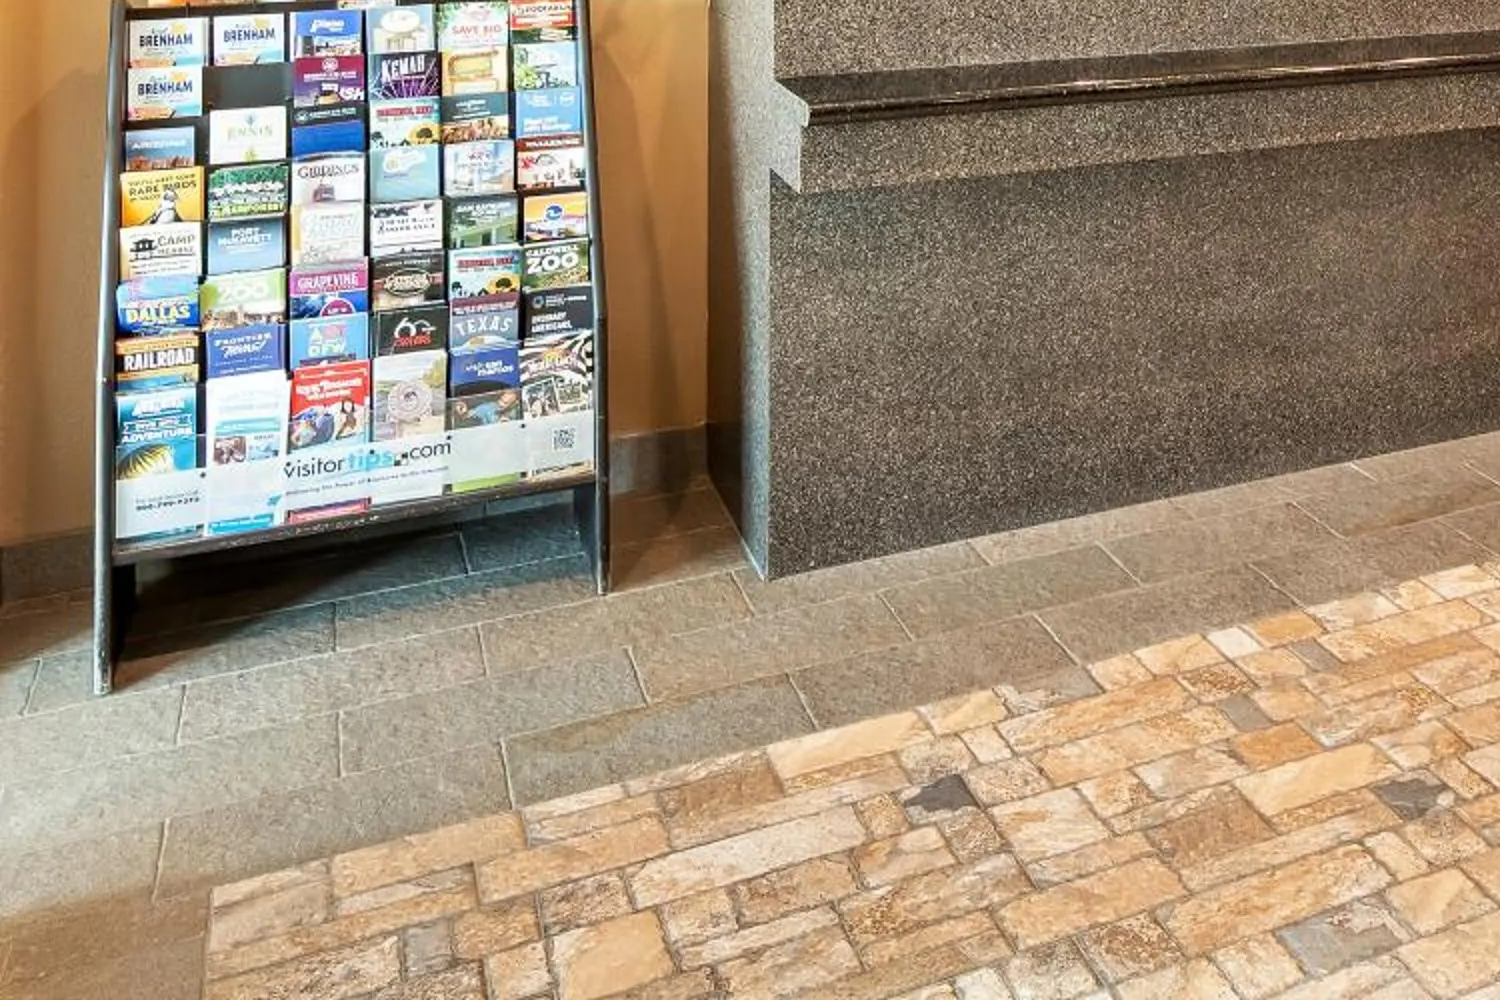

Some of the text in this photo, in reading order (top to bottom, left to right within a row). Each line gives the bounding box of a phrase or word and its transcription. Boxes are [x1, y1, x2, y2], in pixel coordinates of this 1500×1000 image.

[140, 33, 193, 47] BRENHAM
[223, 28, 276, 43] BRENHAM
[381, 54, 426, 82] KEMAH
[138, 80, 193, 96] BRENHAM
[298, 163, 360, 179] GIDDINGS
[129, 184, 159, 197] RARE
[157, 234, 195, 247] CAMP
[527, 252, 579, 274] ZOO
[298, 273, 357, 289] GRAPEVINE
[218, 282, 269, 301] ZOO
[125, 304, 190, 323] DALLAS
[454, 315, 513, 337] TEXAS
[124, 348, 195, 371] RAILROAD
[122, 428, 193, 443] ADVENTURE
